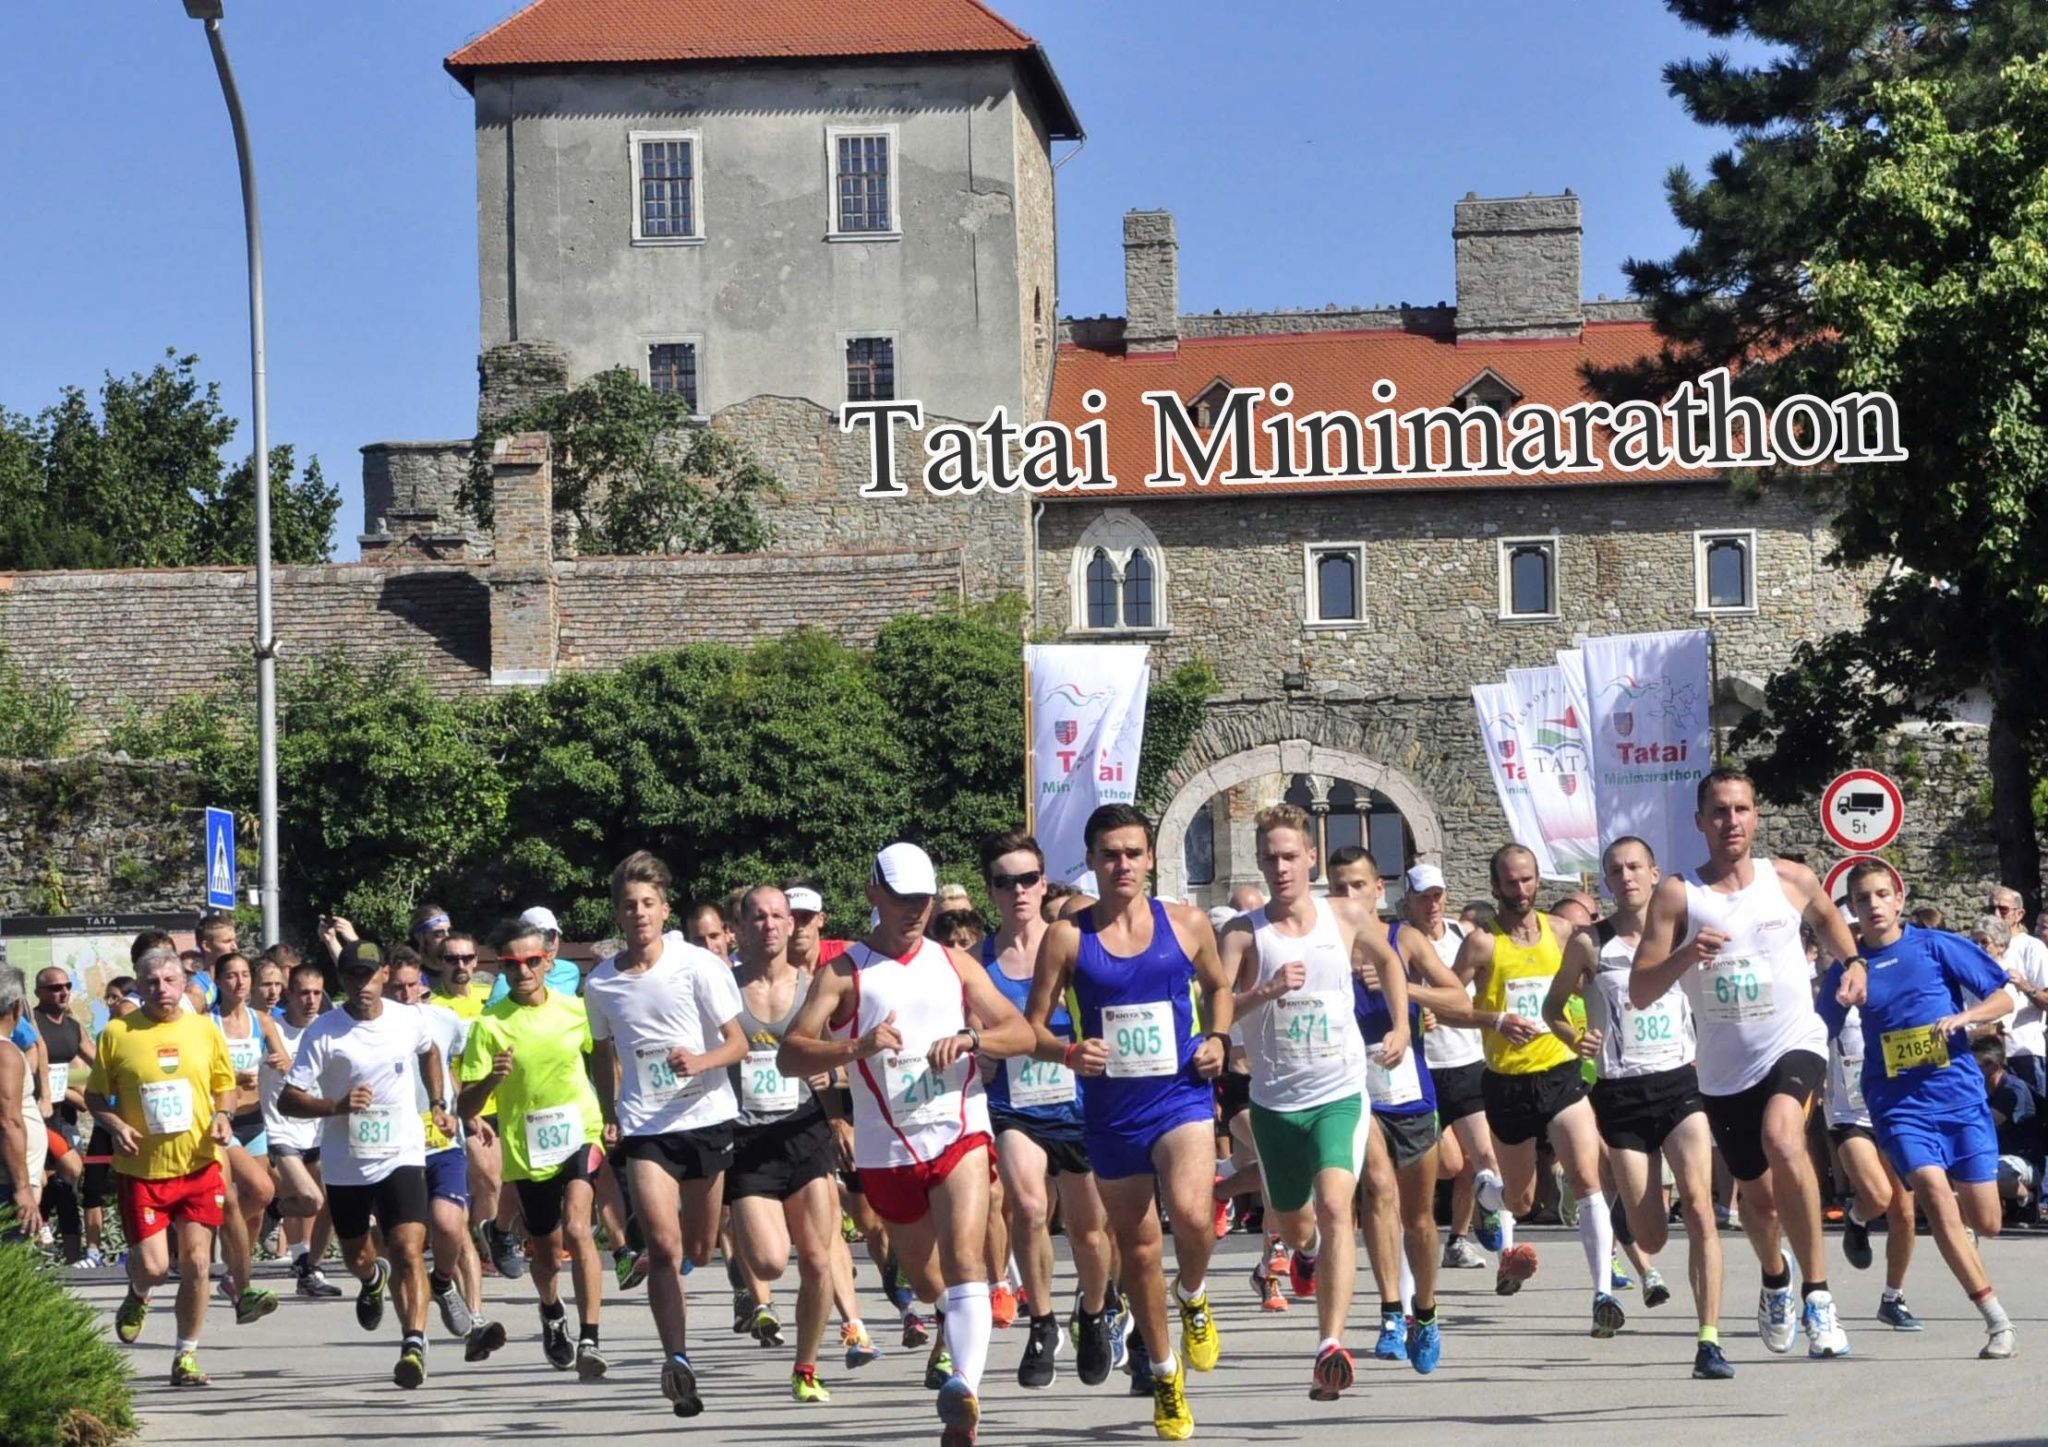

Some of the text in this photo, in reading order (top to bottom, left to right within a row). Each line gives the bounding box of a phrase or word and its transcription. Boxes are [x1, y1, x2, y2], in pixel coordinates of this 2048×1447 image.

[1616, 739, 1687, 765] Tatai
[1604, 769, 1702, 785] Minimarathon
[86, 917, 116, 925] TATA
[1715, 973, 1758, 1004] 670
[1517, 994, 1546, 1017] 63
[1287, 1014, 1328, 1042] 471
[1634, 1014, 1672, 1041] 382
[1117, 1025, 1161, 1057] 905
[1896, 1040, 1932, 1059] 2185
[753, 1069, 786, 1094] 281
[902, 1072, 945, 1104] 215
[150, 1096, 182, 1120] 755
[359, 1121, 390, 1142] 831
[538, 1122, 570, 1149] 837
